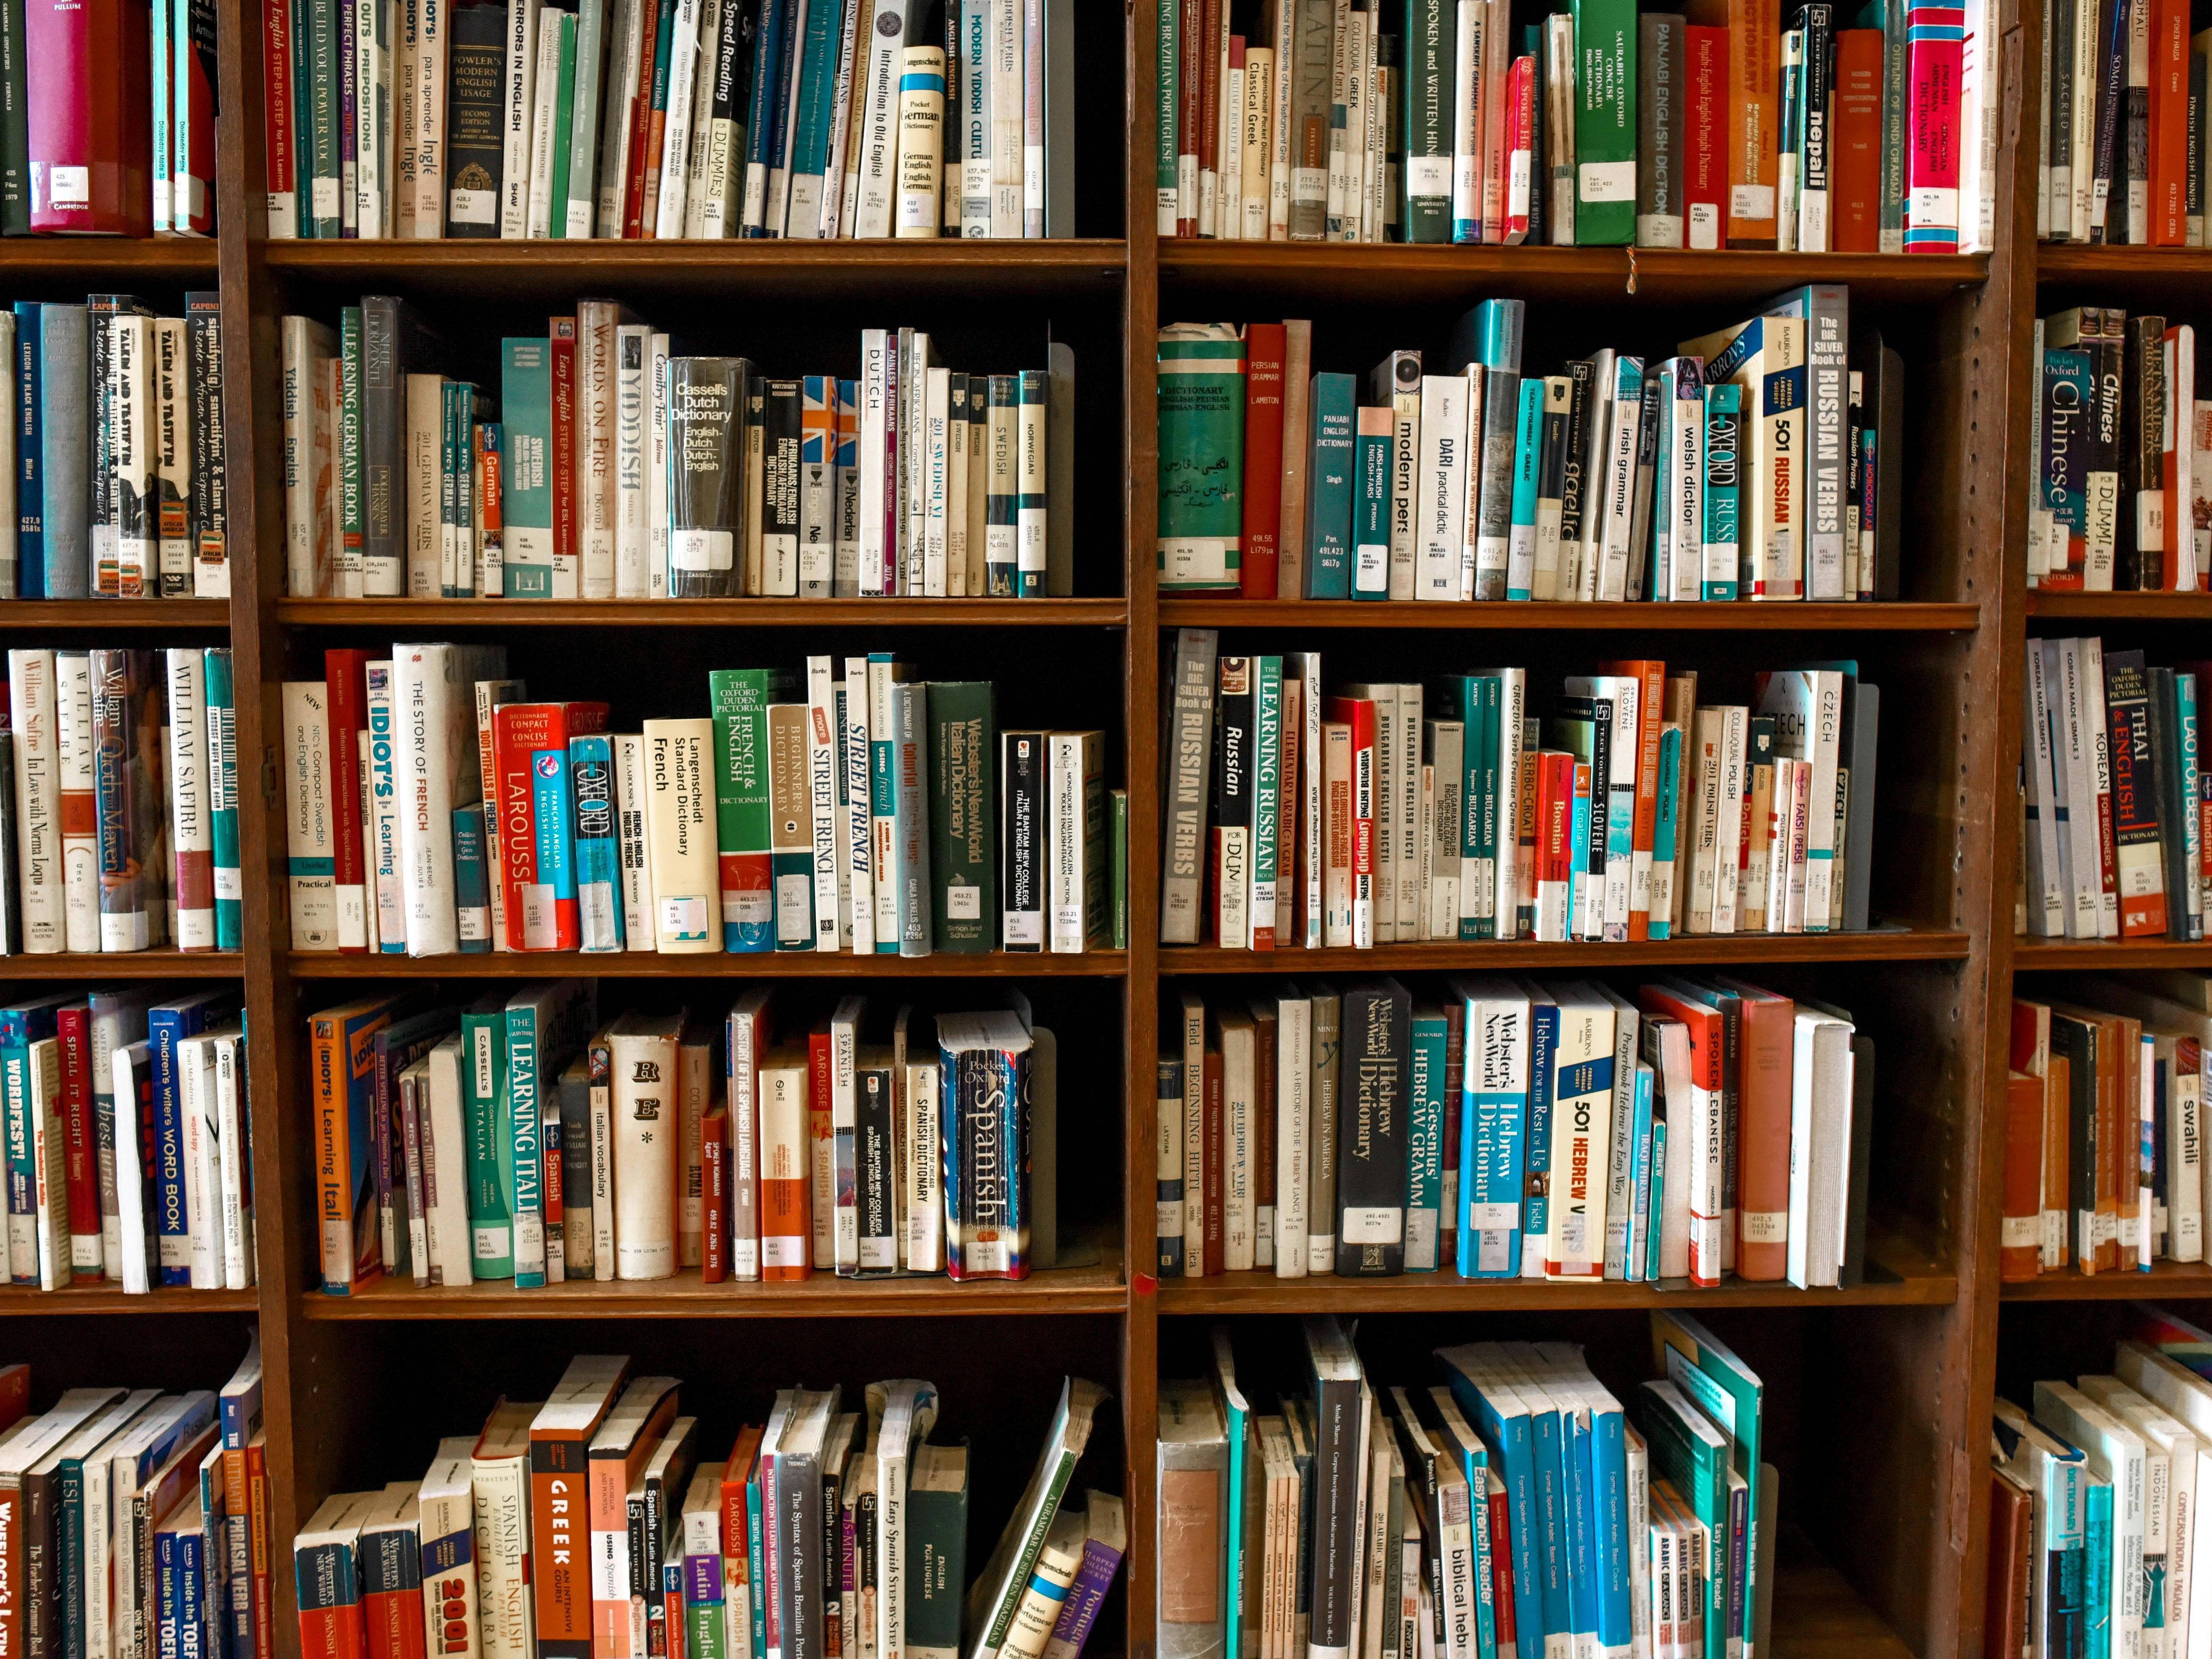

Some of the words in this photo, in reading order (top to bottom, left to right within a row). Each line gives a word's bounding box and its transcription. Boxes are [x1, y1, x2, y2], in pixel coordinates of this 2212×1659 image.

[344, 5, 352, 46] PERFECT
[724, 1, 737, 43] Speed
[970, 15, 982, 66] MODERN
[344, 49, 352, 95] PHRASES
[423, 57, 432, 80] para
[716, 47, 734, 102] Reading
[878, 49, 893, 110] Introduction
[1161, 26, 1172, 85] BRAZILIAN
[273, 53, 284, 126] STEP-BY-STEP
[362, 49, 371, 151] PREPOSITIONS
[456, 78, 496, 87] ENGLISH
[460, 89, 492, 98] USAGE
[970, 71, 982, 114] YIDDISH
[1248, 62, 1259, 110] Classical
[1616, 86, 1624, 127] OXFORD
[423, 85, 433, 134] aprender
[875, 126, 886, 140] Old
[1161, 88, 1173, 162] PORTUGUESE
[1248, 114, 1256, 145] Greek
[709, 130, 726, 196] DUMMIES
[1806, 111, 1823, 186] nepali
[344, 332, 356, 413] LEARNING
[593, 323, 609, 395] WORDS
[870, 350, 880, 409] DUTCH
[285, 368, 297, 420] Yiddish
[593, 401, 606, 427] ON
[676, 383, 728, 396] Cassell's
[684, 397, 719, 408] Dutch
[1818, 370, 1839, 459] RUSSIAN
[672, 409, 731, 423] Dictionary
[1620, 428, 1631, 455] irish
[1776, 419, 1790, 451] 501
[2051, 381, 2079, 503] Chinese
[285, 437, 298, 487] English
[344, 414, 356, 477] GERMAN
[593, 437, 609, 478] FIRE
[1399, 422, 1413, 491] modern
[1439, 438, 1453, 467] DARI
[345, 483, 357, 526] BOOK
[486, 456, 497, 506] German
[787, 438, 797, 524] AFRIKAANS/ENGLISH
[1326, 475, 1342, 484] Singh
[1437, 472, 1447, 508] practical
[1615, 460, 1627, 517] grammar
[1774, 457, 1790, 524] RUSSIAN
[1818, 467, 1838, 532] VERBS
[176, 666, 193, 757] WILLIAM
[303, 693, 321, 711] NEW
[413, 681, 423, 706] THE
[1823, 691, 1833, 742] CZECH
[371, 707, 393, 797] IDIOT'S
[413, 711, 425, 753] STORY
[815, 714, 826, 738] more
[1259, 682, 1278, 783] LEARNING
[2132, 707, 2149, 761] THAI
[416, 757, 425, 774] OF
[675, 737, 686, 790] Standard
[688, 737, 704, 824] Langenscheidt
[850, 723, 866, 796] STREET
[2095, 733, 2108, 790] KOREAN
[178, 766, 197, 837] SAFIRE
[416, 779, 428, 831] FRENCH
[876, 775, 889, 810] french
[677, 796, 688, 856] Dictionary
[852, 800, 869, 873] FRENCH
[1258, 789, 1277, 870] RUSSIAN
[1552, 801, 1565, 853] Bosnian
[1577, 808, 1586, 845] Croatian
[67, 1036, 76, 1077] SPELL
[160, 1029, 170, 1085] Children's
[479, 1036, 488, 1091] CASSELL'S
[7, 1059, 25, 1160] WORDFEST!
[70, 1085, 78, 1097] IT
[162, 1088, 172, 1126] Writer's
[512, 1044, 536, 1152] LEARNING
[1188, 1064, 1200, 1144] BEGINNING
[71, 1104, 82, 1146] RIGHT
[917, 1099, 927, 1141] SPANISH
[1425, 1101, 1441, 1179] Gesenius'
[1497, 1103, 1518, 1179] Hebrew
[1709, 1091, 1719, 1164] LEBANESE
[2184, 1100, 2199, 1164] swahili
[164, 1129, 177, 1180] WORD
[596, 1144, 605, 1198] vocabulary
[917, 1143, 927, 1203] DICTIONARY
[967, 1090, 1005, 1218] Spanish
[166, 1184, 180, 1231] BOOK
[1531, 1202, 1542, 1229] Fields
[63, 1480, 78, 1507] ESL
[1473, 1466, 1487, 1500] Easy
[2152, 1464, 2161, 1536] INDONESIAN
[551, 1480, 570, 1565] GREEK
[730, 1498, 740, 1555] LAROUSSE
[888, 1500, 899, 1525] Easy
[1475, 1503, 1490, 1551] French
[888, 1529, 899, 1572] Spanish
[1452, 1548, 1466, 1607] biblical
[1479, 1554, 1492, 1605] Reader
[443, 1578, 467, 1654] 2001
[888, 1577, 899, 1646] STEP-BY-STEP
